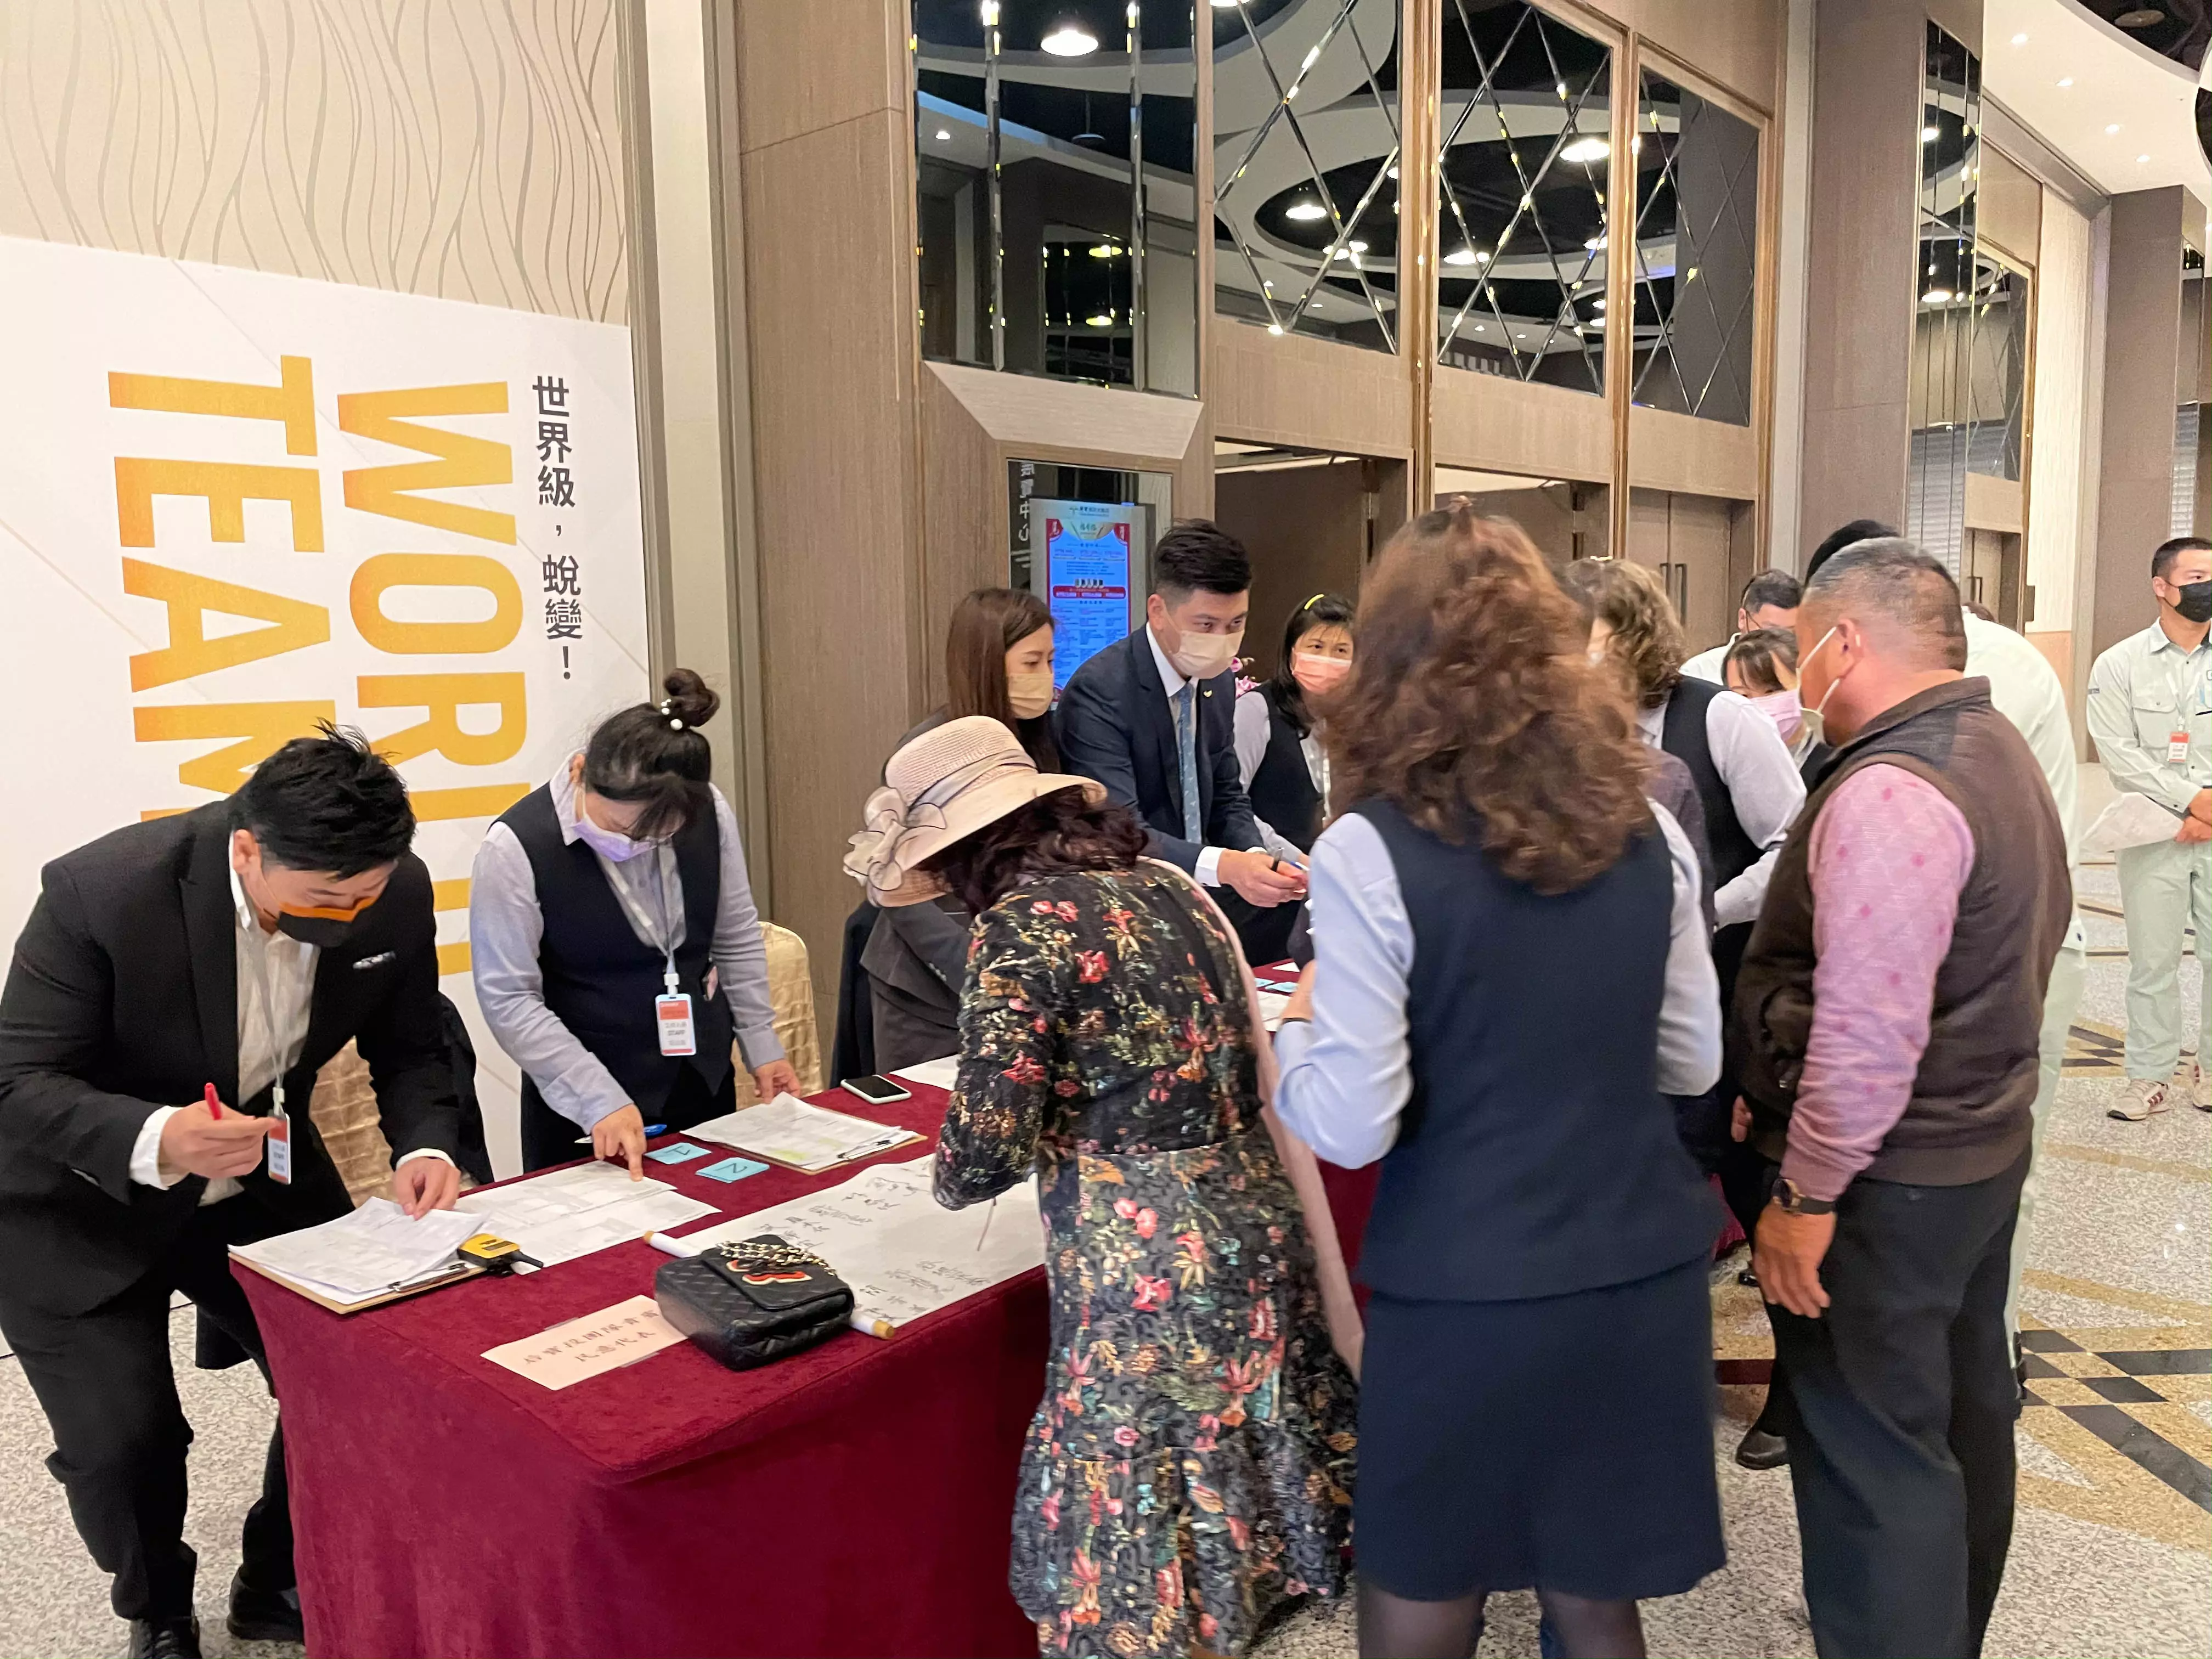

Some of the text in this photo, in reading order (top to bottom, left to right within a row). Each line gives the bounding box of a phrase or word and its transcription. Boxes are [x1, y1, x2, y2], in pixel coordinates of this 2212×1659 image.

[338, 381, 531, 976] WOR
[532, 375, 583, 680] 世界級，蛻變！
